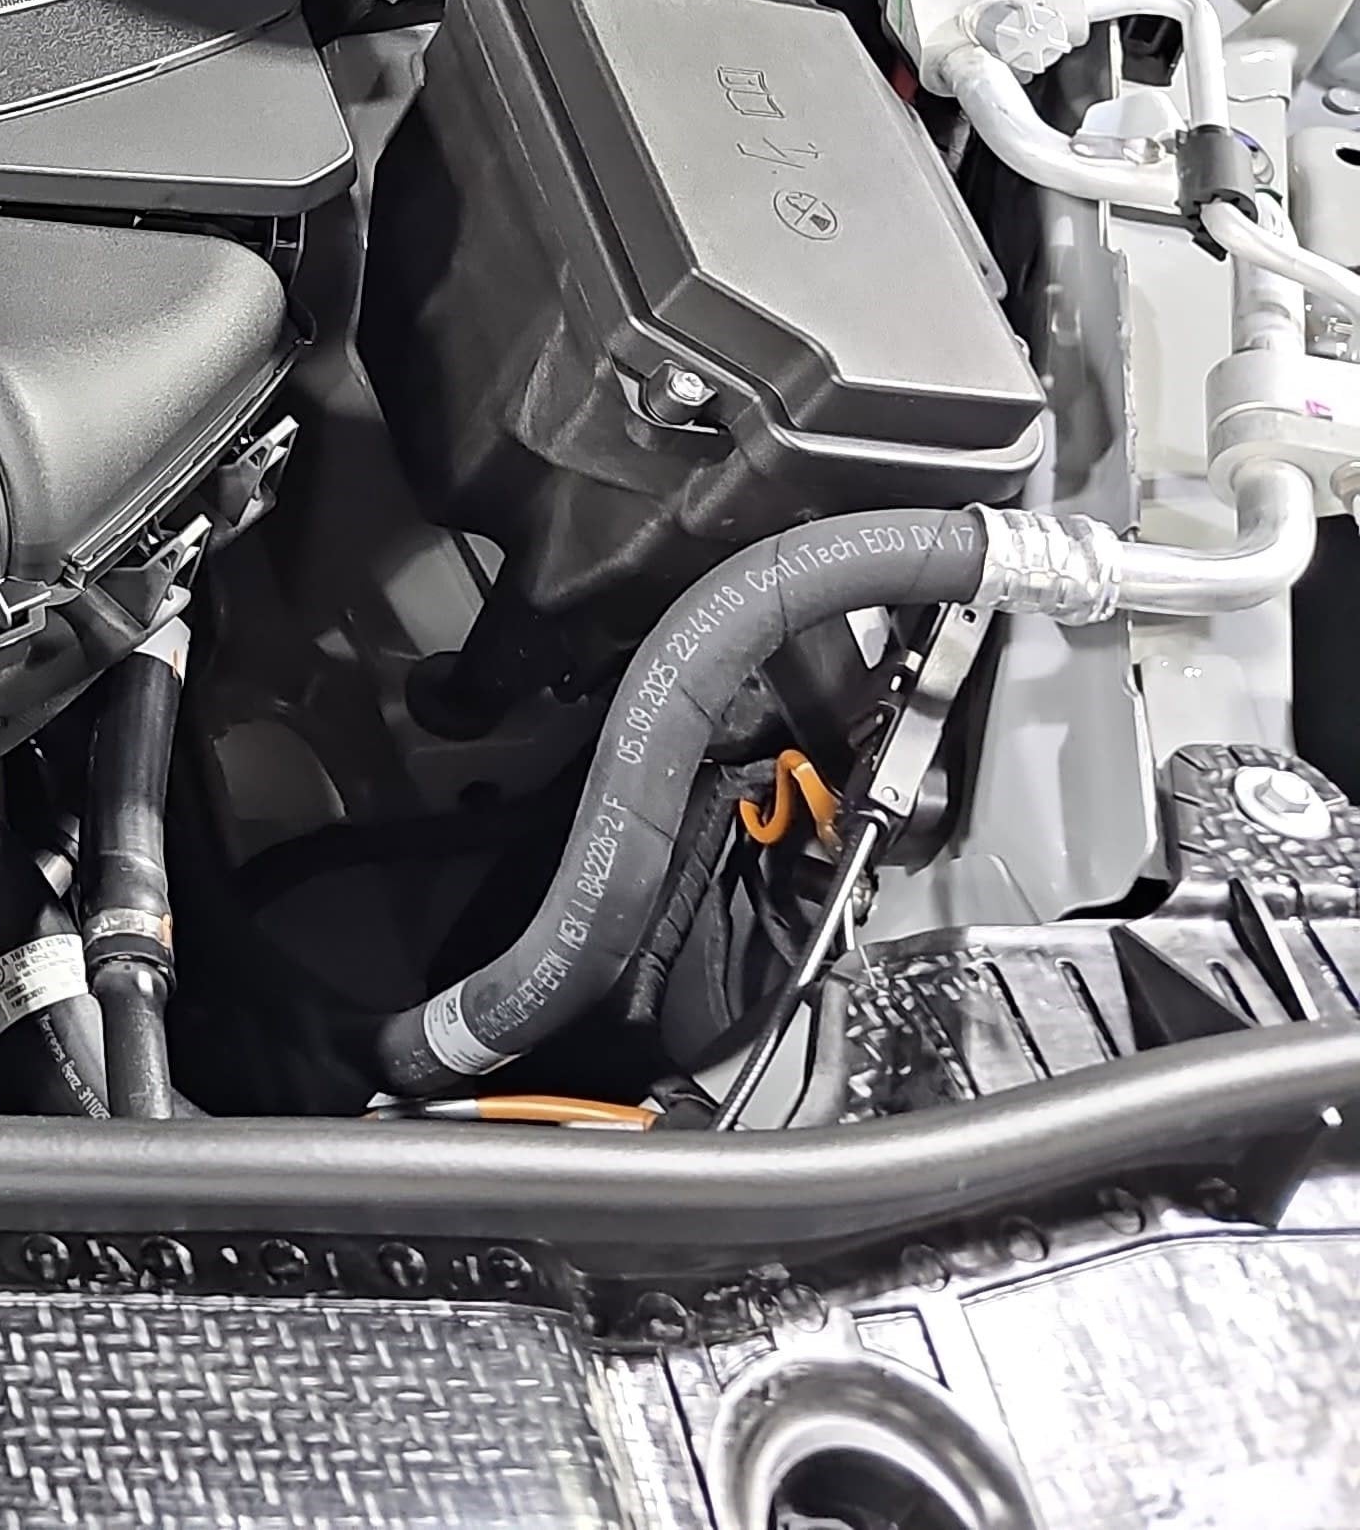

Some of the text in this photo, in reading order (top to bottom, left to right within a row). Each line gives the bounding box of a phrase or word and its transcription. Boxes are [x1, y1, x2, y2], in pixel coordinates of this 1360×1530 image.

[602, 792, 628, 812] F
[616, 657, 678, 765] 05.09.2025
[665, 585, 745, 662] 22:41:18
[744, 535, 860, 593] ContiTech
[859, 527, 906, 554] ECO
[909, 525, 946, 552] DN
[950, 527, 975, 552] 17
